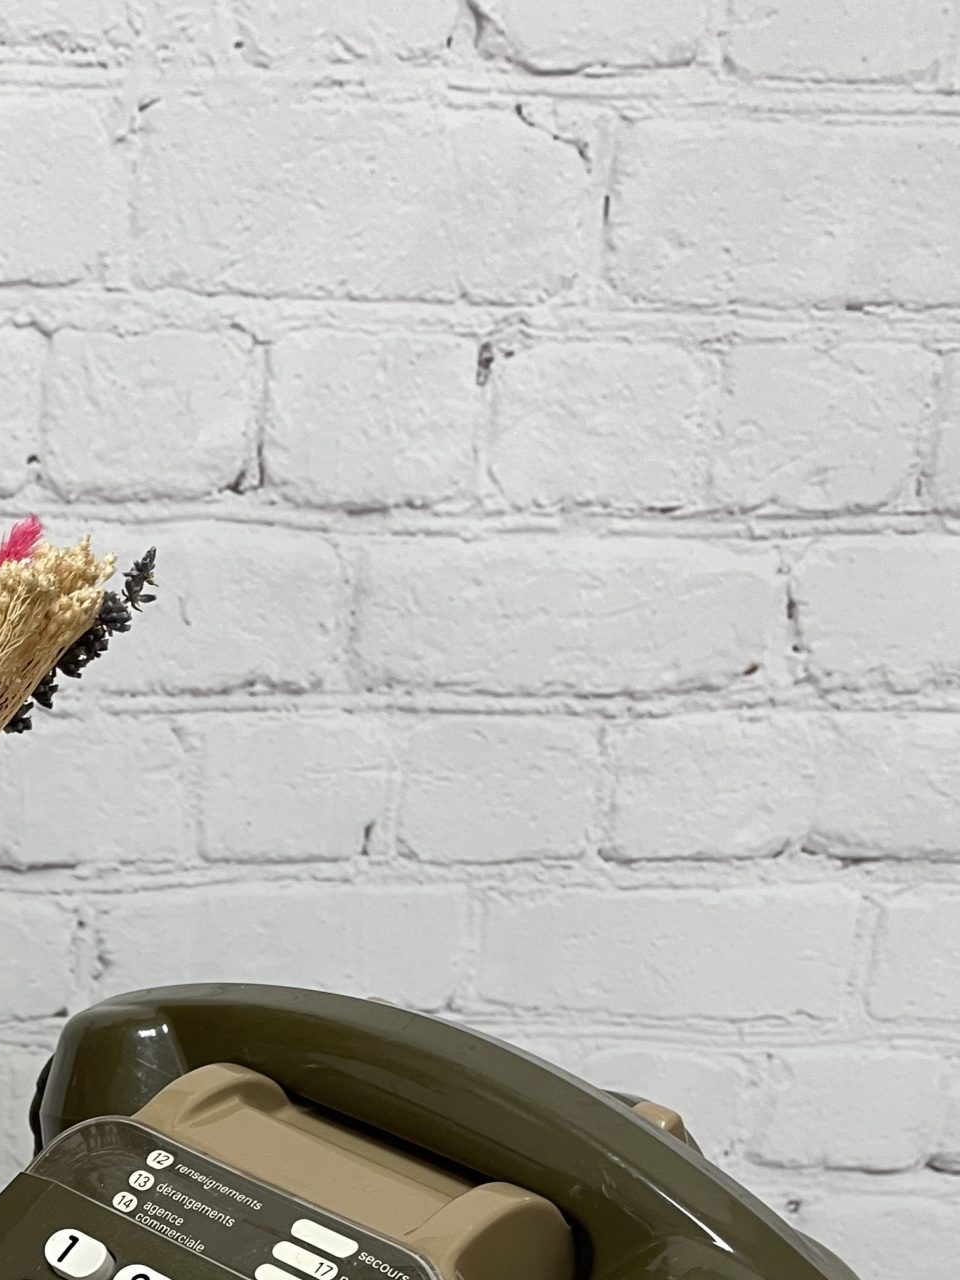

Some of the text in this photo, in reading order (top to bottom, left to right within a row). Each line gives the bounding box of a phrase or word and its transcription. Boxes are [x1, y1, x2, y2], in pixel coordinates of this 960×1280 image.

[152, 1152, 263, 1210] 12 renseignements
[117, 1194, 184, 1226] 14 agence
[133, 1172, 235, 1227] 13 dérangements
[57, 1235, 79, 1262] 1
[135, 1212, 205, 1252] commerciale
[314, 1261, 334, 1277] 17
